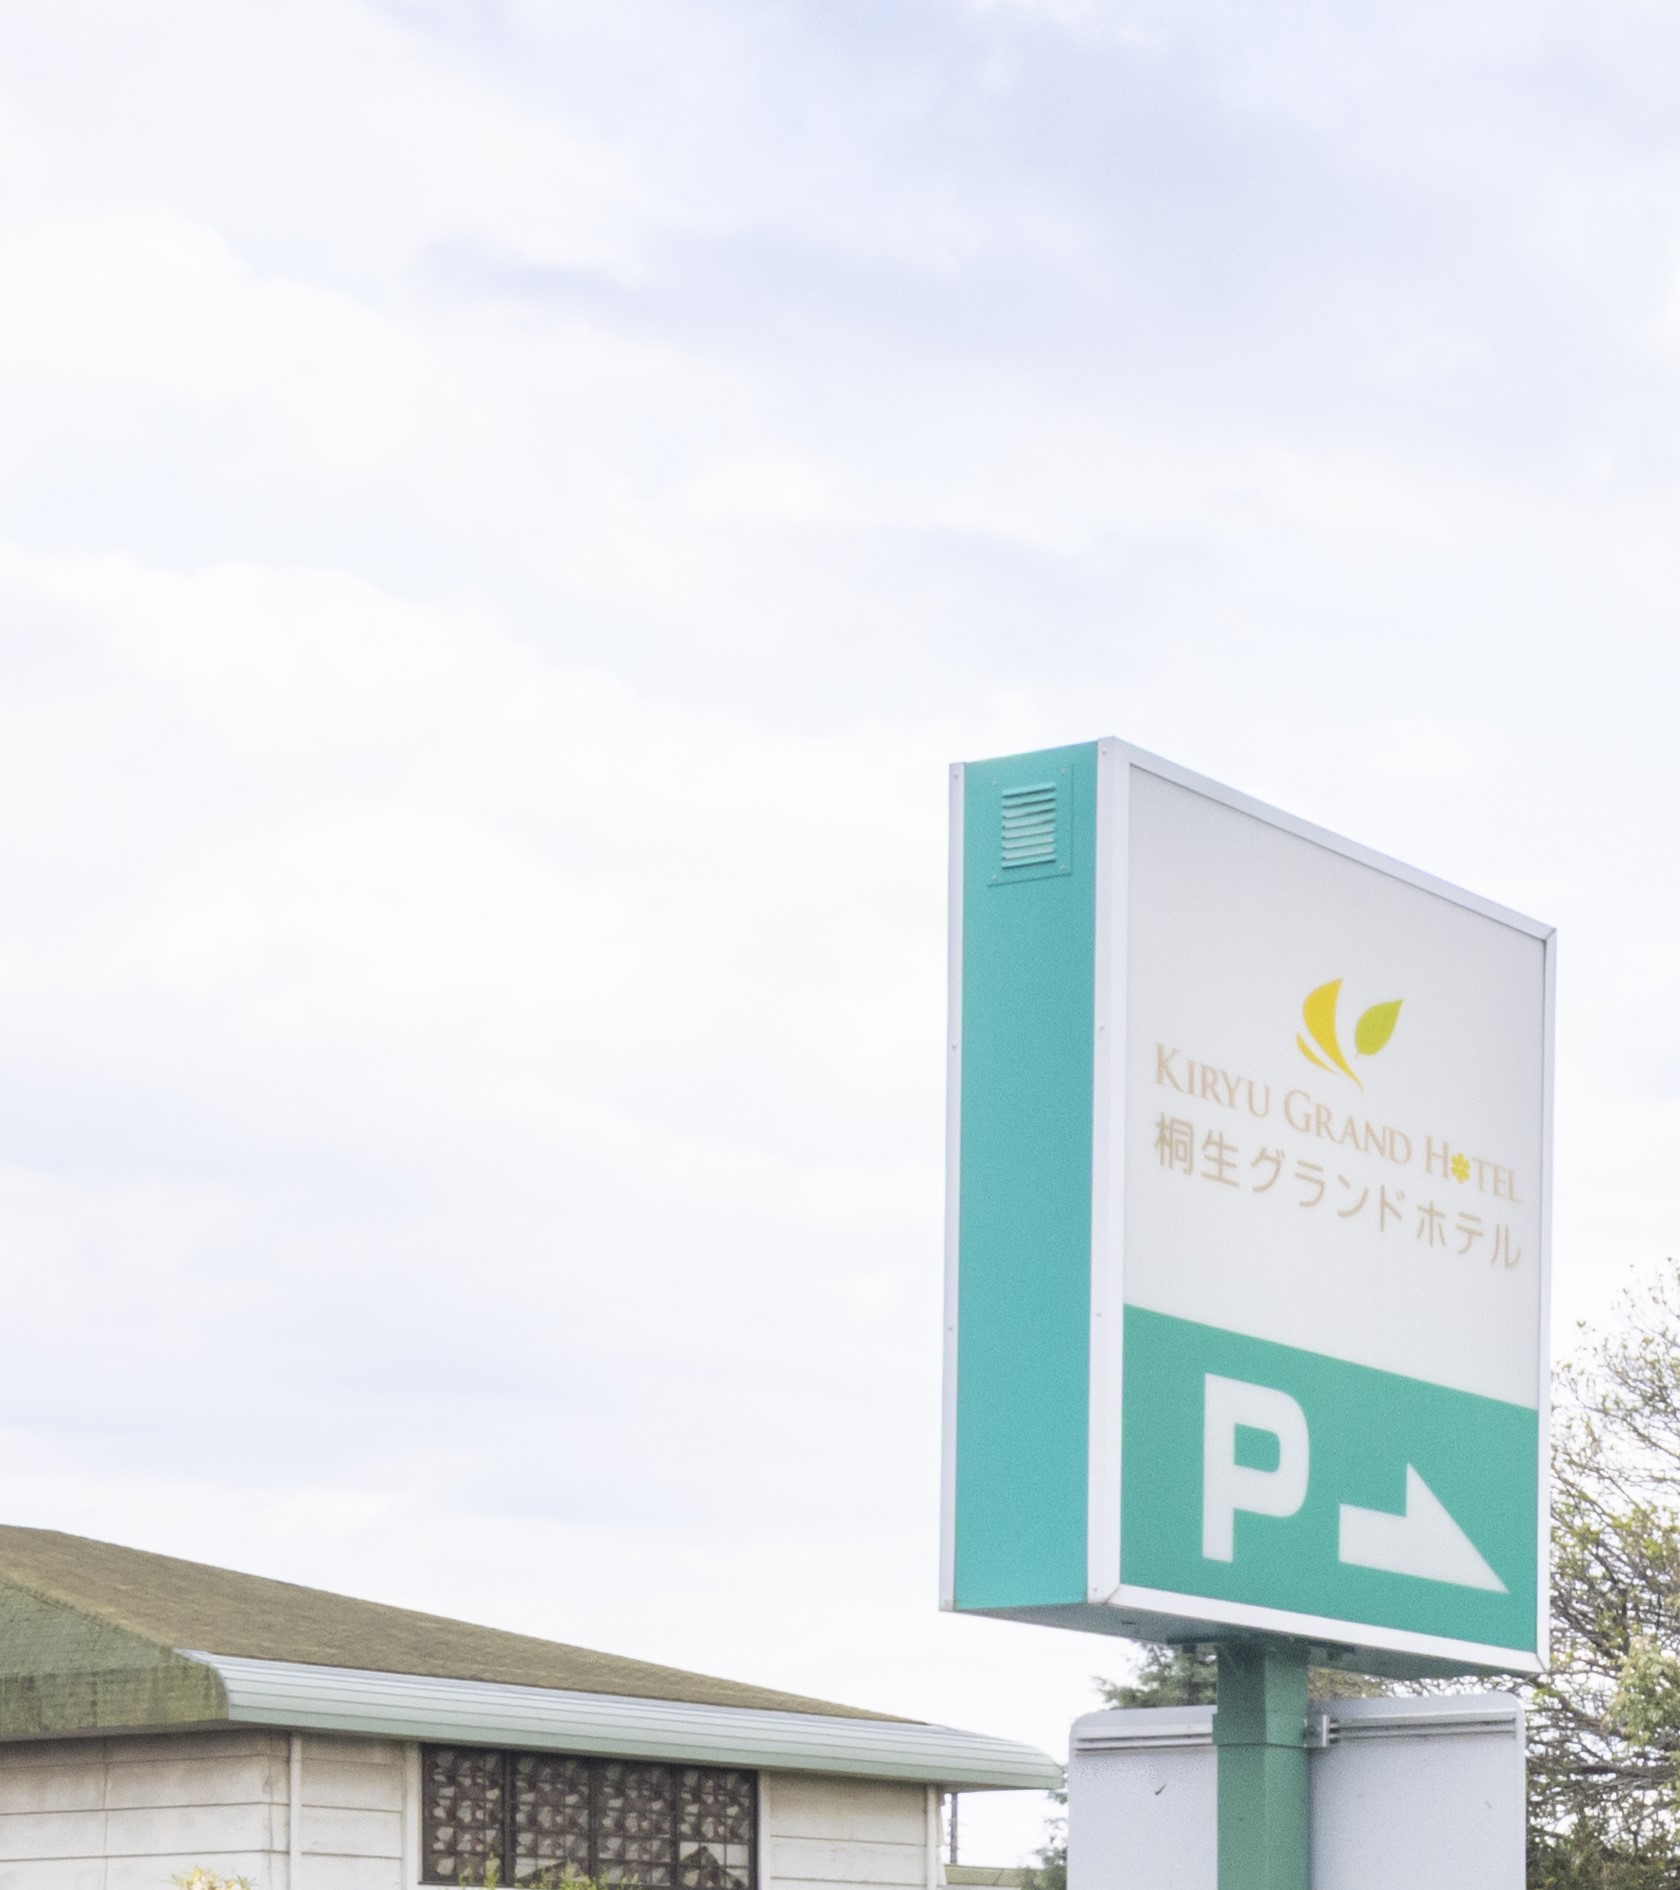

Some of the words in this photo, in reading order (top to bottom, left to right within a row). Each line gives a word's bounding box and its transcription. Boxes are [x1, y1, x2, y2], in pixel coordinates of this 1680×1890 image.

[1155, 1041, 1272, 1119] KIRYU
[1283, 1088, 1413, 1166] GRAND
[1154, 1111, 1523, 1269] 桐生グランドホテル
[1202, 1372, 1310, 1564] P
